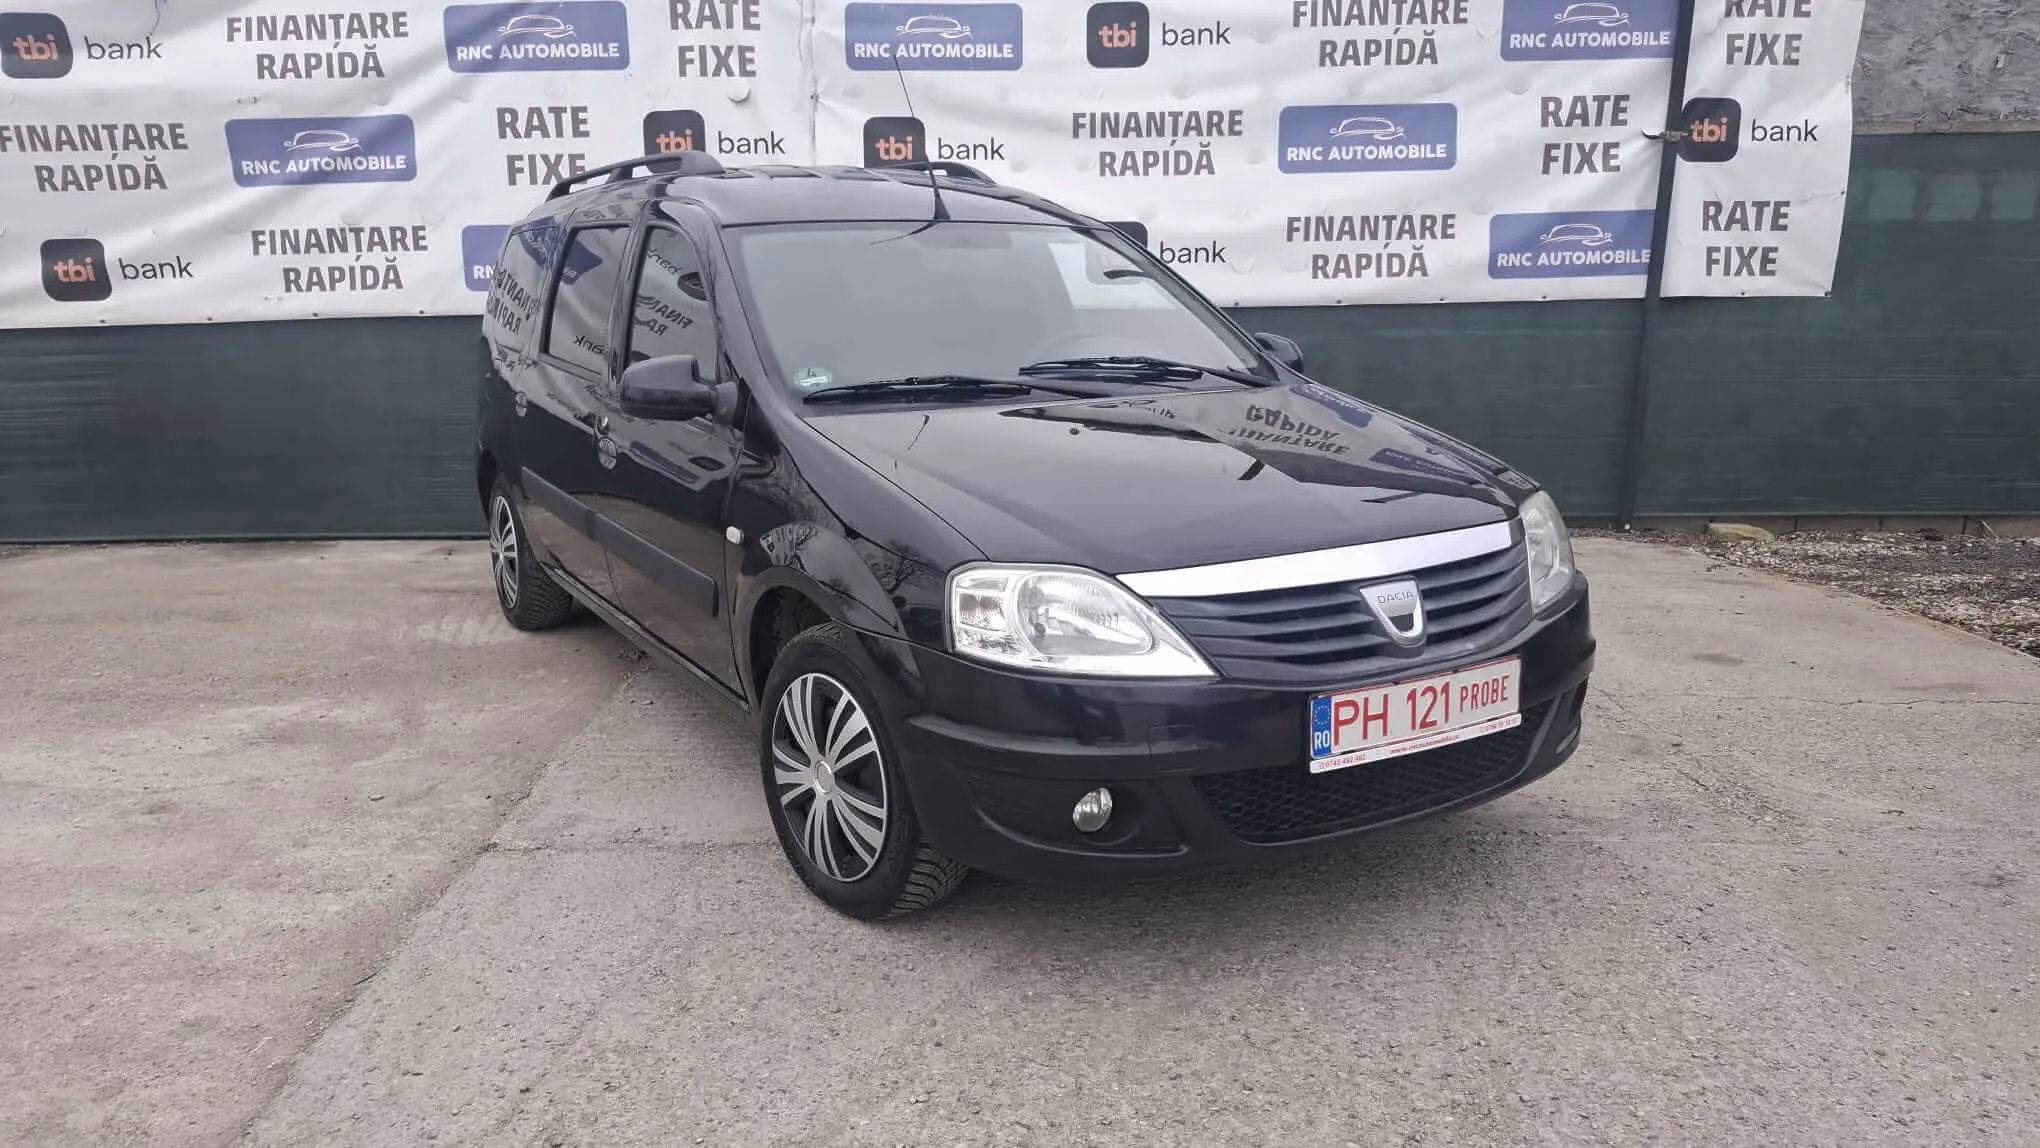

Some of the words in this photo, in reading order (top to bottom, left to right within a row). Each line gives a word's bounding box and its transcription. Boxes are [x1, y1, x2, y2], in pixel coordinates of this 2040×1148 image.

[669, 0, 761, 31] RATE
[13, 34, 58, 61] tbi
[85, 36, 162, 60] bank
[1099, 22, 1137, 48] tbi
[1162, 21, 1231, 46] bank
[1509, 33, 1546, 49] RNC
[1551, 31, 1670, 48] AUTOMOBILE
[457, 45, 492, 61] RNC
[499, 42, 620, 59] AUTOMOBILE
[678, 45, 757, 78] FIXE
[854, 43, 890, 58] RNC
[895, 42, 1014, 58] AUTOMOBILE
[1726, 33, 1802, 66] FIXE
[496, 106, 590, 139] RATE
[1540, 94, 1630, 128] RATE
[656, 129, 692, 152] tbi
[718, 130, 785, 154] bank
[1690, 117, 1728, 142] tbi
[1752, 119, 1818, 142] bank
[875, 136, 913, 161] tbi
[938, 136, 1005, 161] bank
[1287, 147, 1323, 161] RNC
[1328, 144, 1447, 160] AUTOMOBILE
[1542, 142, 1621, 175] FIXE
[241, 159, 280, 175] RNC
[286, 155, 407, 173] AUTOMOBILE
[507, 153, 585, 185] FIXE
[1702, 200, 1791, 232] RATE
[1160, 240, 1226, 263] bank
[1497, 252, 1532, 267] RNC
[1536, 249, 1651, 266] AUTOMOBILE
[1705, 246, 1779, 277] FIXE
[54, 256, 95, 283] tbi
[118, 255, 194, 280] bank
[1377, 591, 1414, 604] DACIA
[1334, 693, 1388, 746] PH
[1407, 681, 1449, 730] 121
[1460, 675, 1509, 712] PROBE
[1315, 731, 1330, 749] RO
